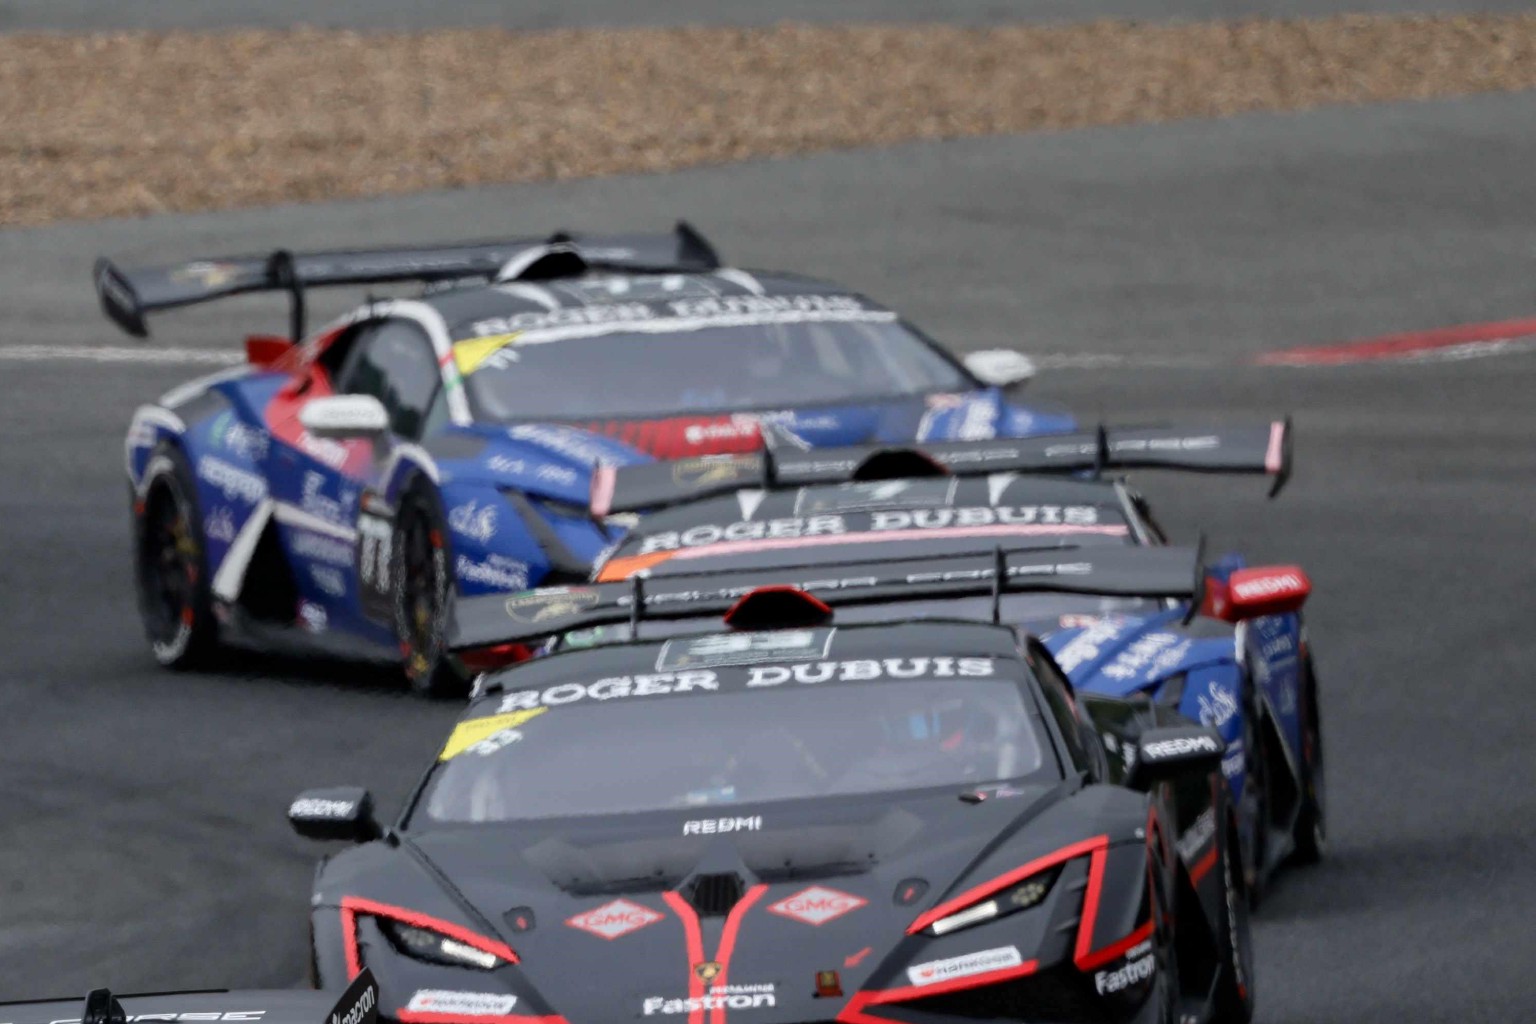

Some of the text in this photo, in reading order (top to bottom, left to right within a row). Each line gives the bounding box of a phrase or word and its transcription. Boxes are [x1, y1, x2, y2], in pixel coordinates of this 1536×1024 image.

[640, 504, 1099, 555] ROGER DUBUIS
[496, 657, 995, 713] ROGER DUBUIS
[683, 815, 763, 836] REDMI
[643, 993, 776, 1016] Fastron
